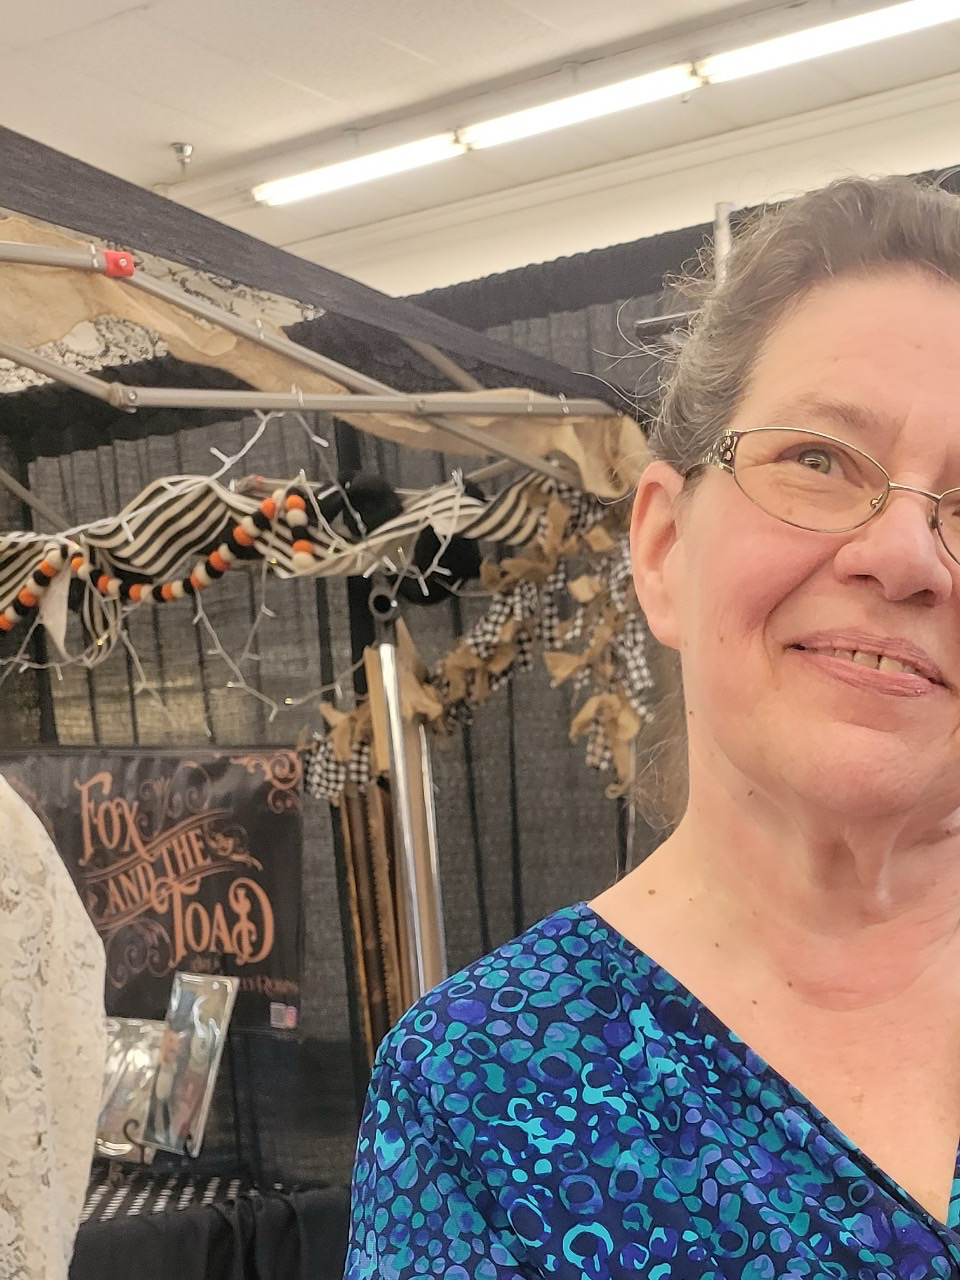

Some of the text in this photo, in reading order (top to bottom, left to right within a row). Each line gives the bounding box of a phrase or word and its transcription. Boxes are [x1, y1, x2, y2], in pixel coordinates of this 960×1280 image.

[103, 828, 212, 918] AND THE
[151, 877, 275, 968] TOAD
